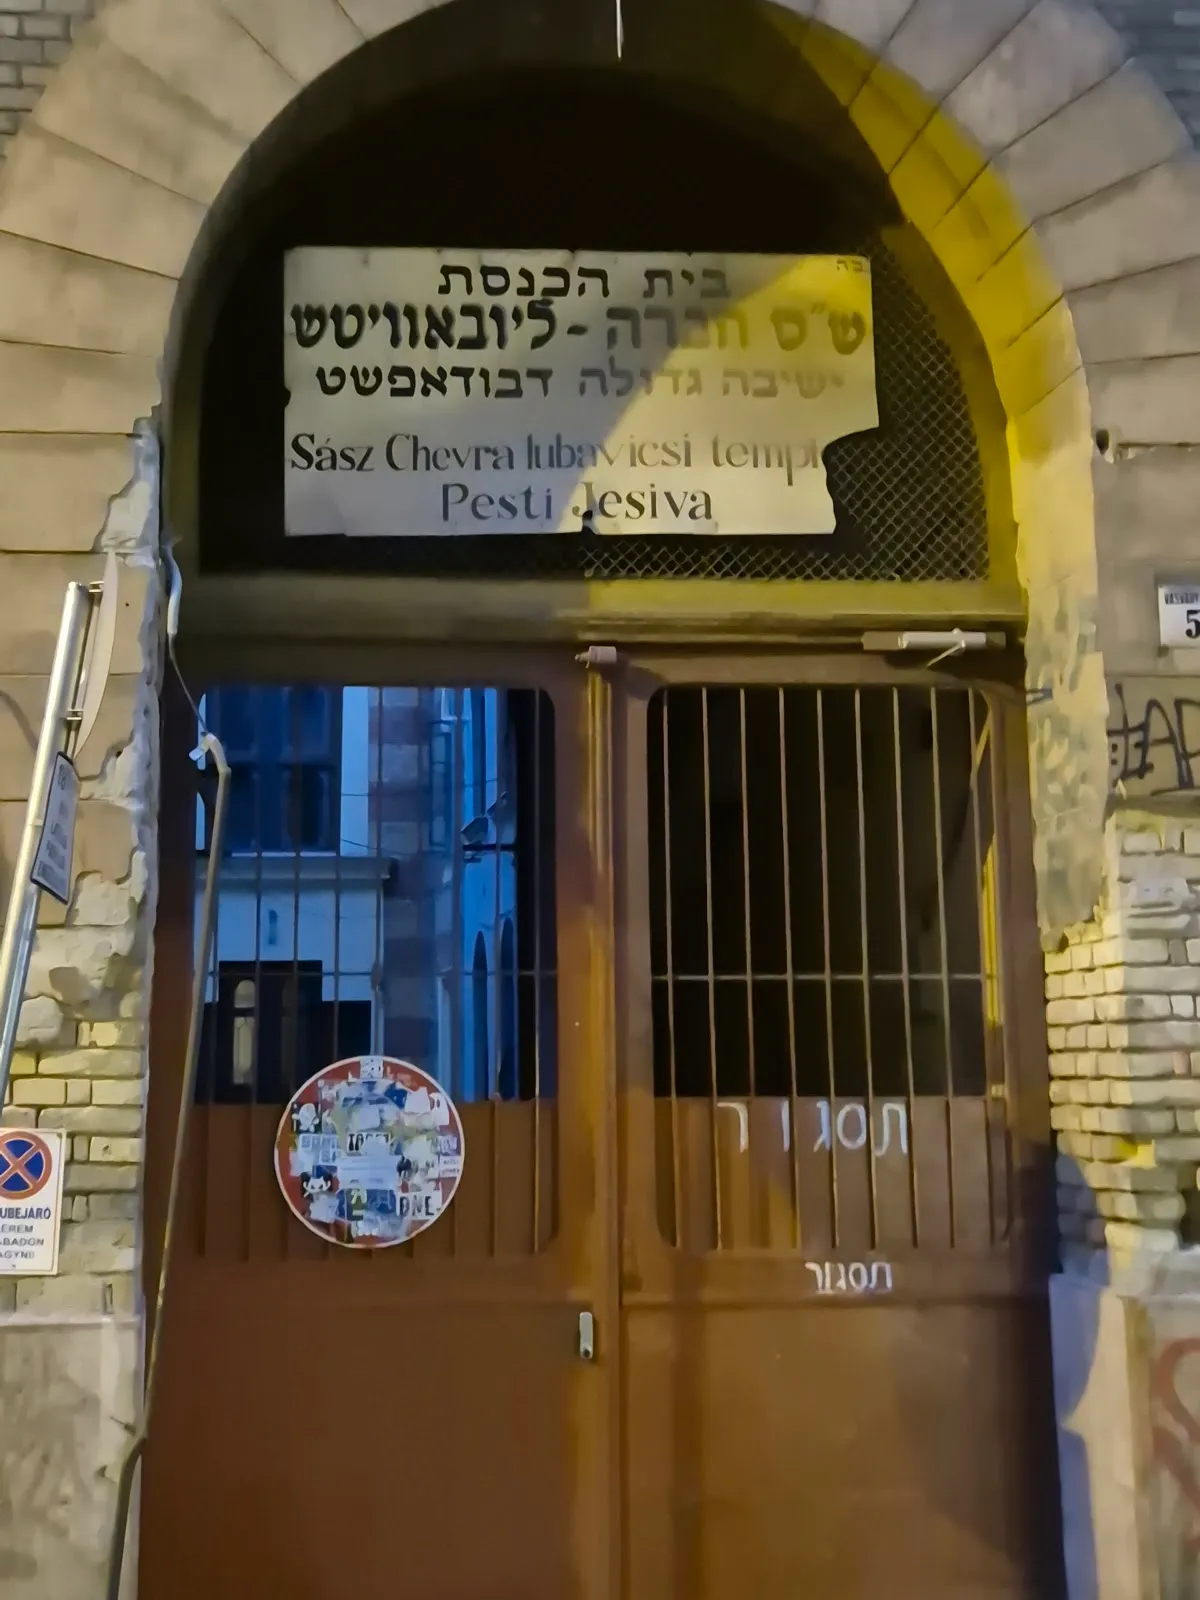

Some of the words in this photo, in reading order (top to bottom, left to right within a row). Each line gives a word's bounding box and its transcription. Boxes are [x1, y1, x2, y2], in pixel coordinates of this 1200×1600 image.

[438, 265, 609, 297] הכנסת
[642, 269, 731, 299] בית
[315, 365, 553, 399] דבודאפשט
[579, 356, 703, 397] גדולה
[722, 367, 846, 400] ישיבה
[290, 433, 375, 472] Sász
[385, 433, 515, 472] Chevra
[526, 432, 692, 471] lubavicsi
[710, 433, 821, 487] templ
[442, 482, 553, 522] Pesti
[571, 481, 713, 521] Jesiva
[0, 1237, 45, 1247] BADON
